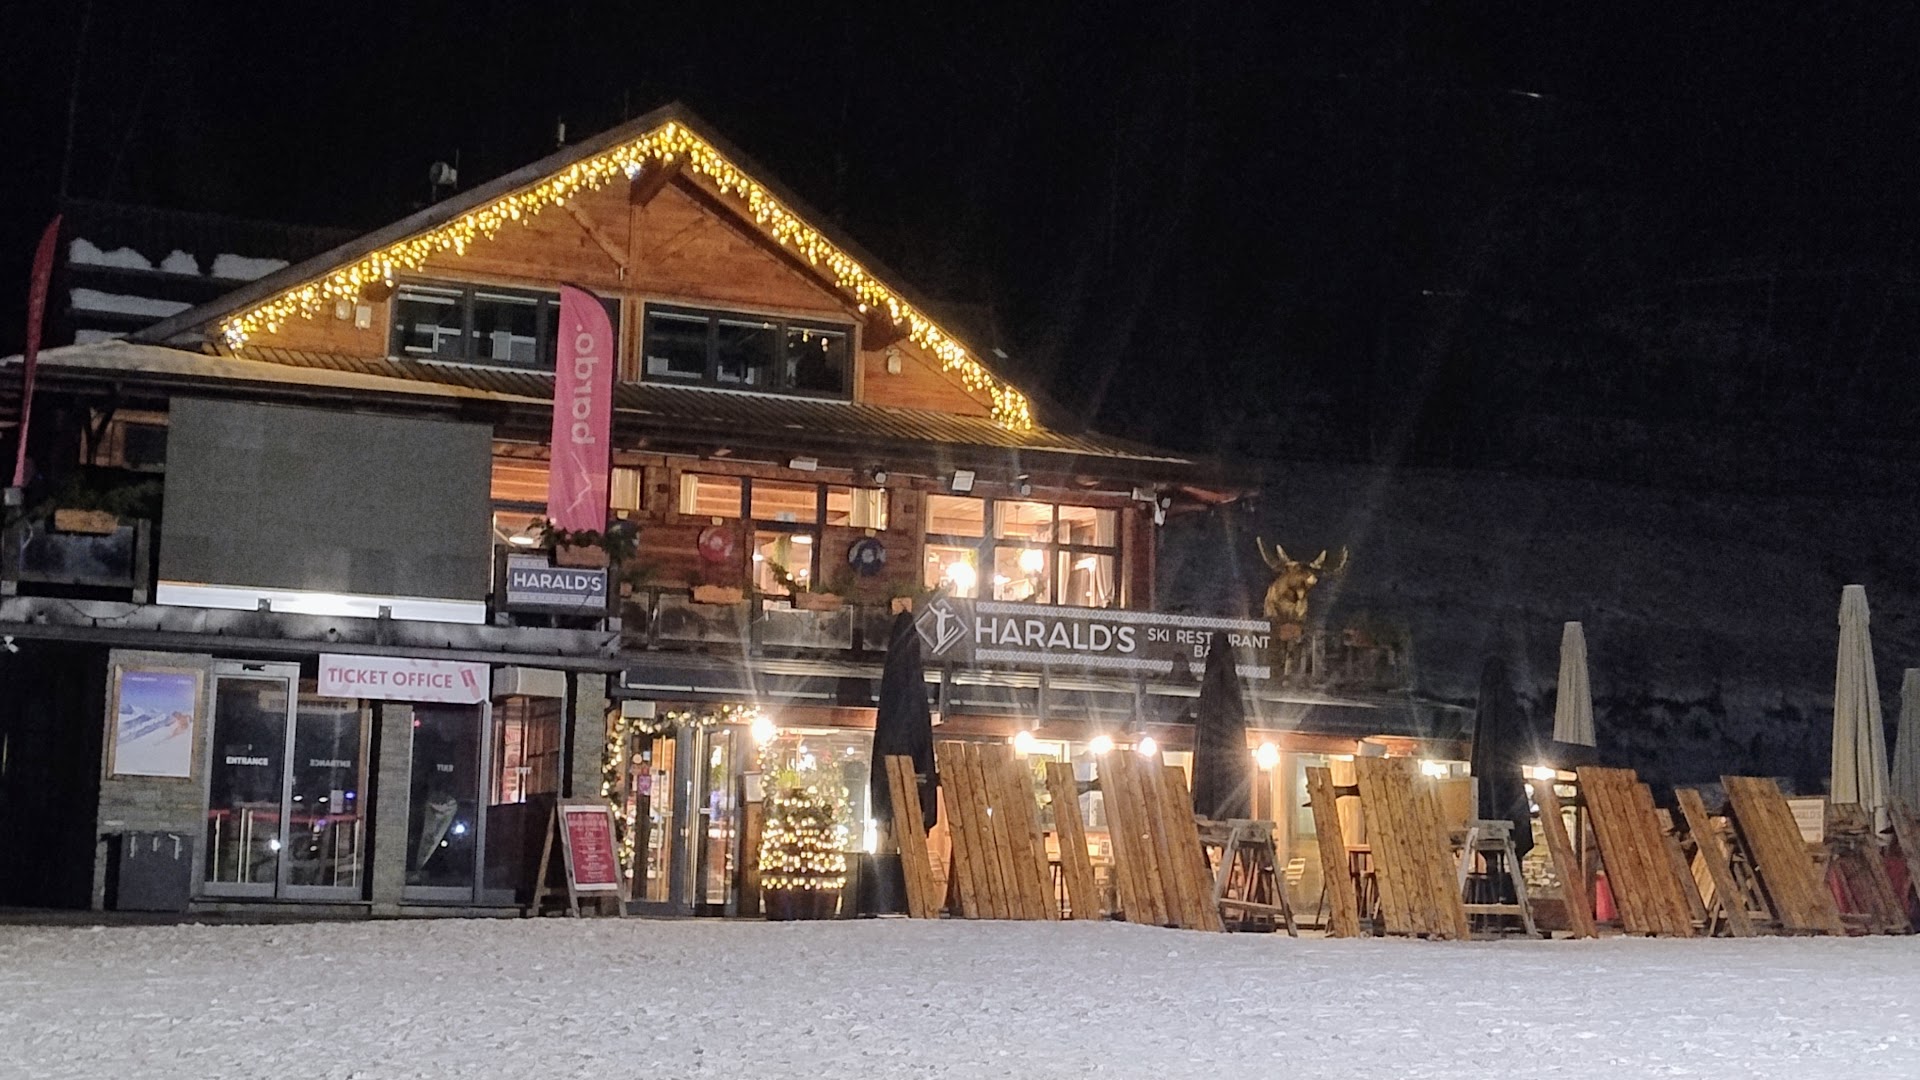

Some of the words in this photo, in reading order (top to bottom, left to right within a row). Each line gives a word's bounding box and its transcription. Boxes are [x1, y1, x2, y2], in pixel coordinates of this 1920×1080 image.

[513, 572, 602, 592] HARALD'S
[975, 616, 1136, 653] HARALD'S
[1147, 627, 1170, 642] SKI
[1176, 629, 1271, 649] RESTRANT
[328, 668, 388, 685] TICKET
[392, 671, 453, 689] OFFICE
[226, 756, 269, 766] ENTRANCE
